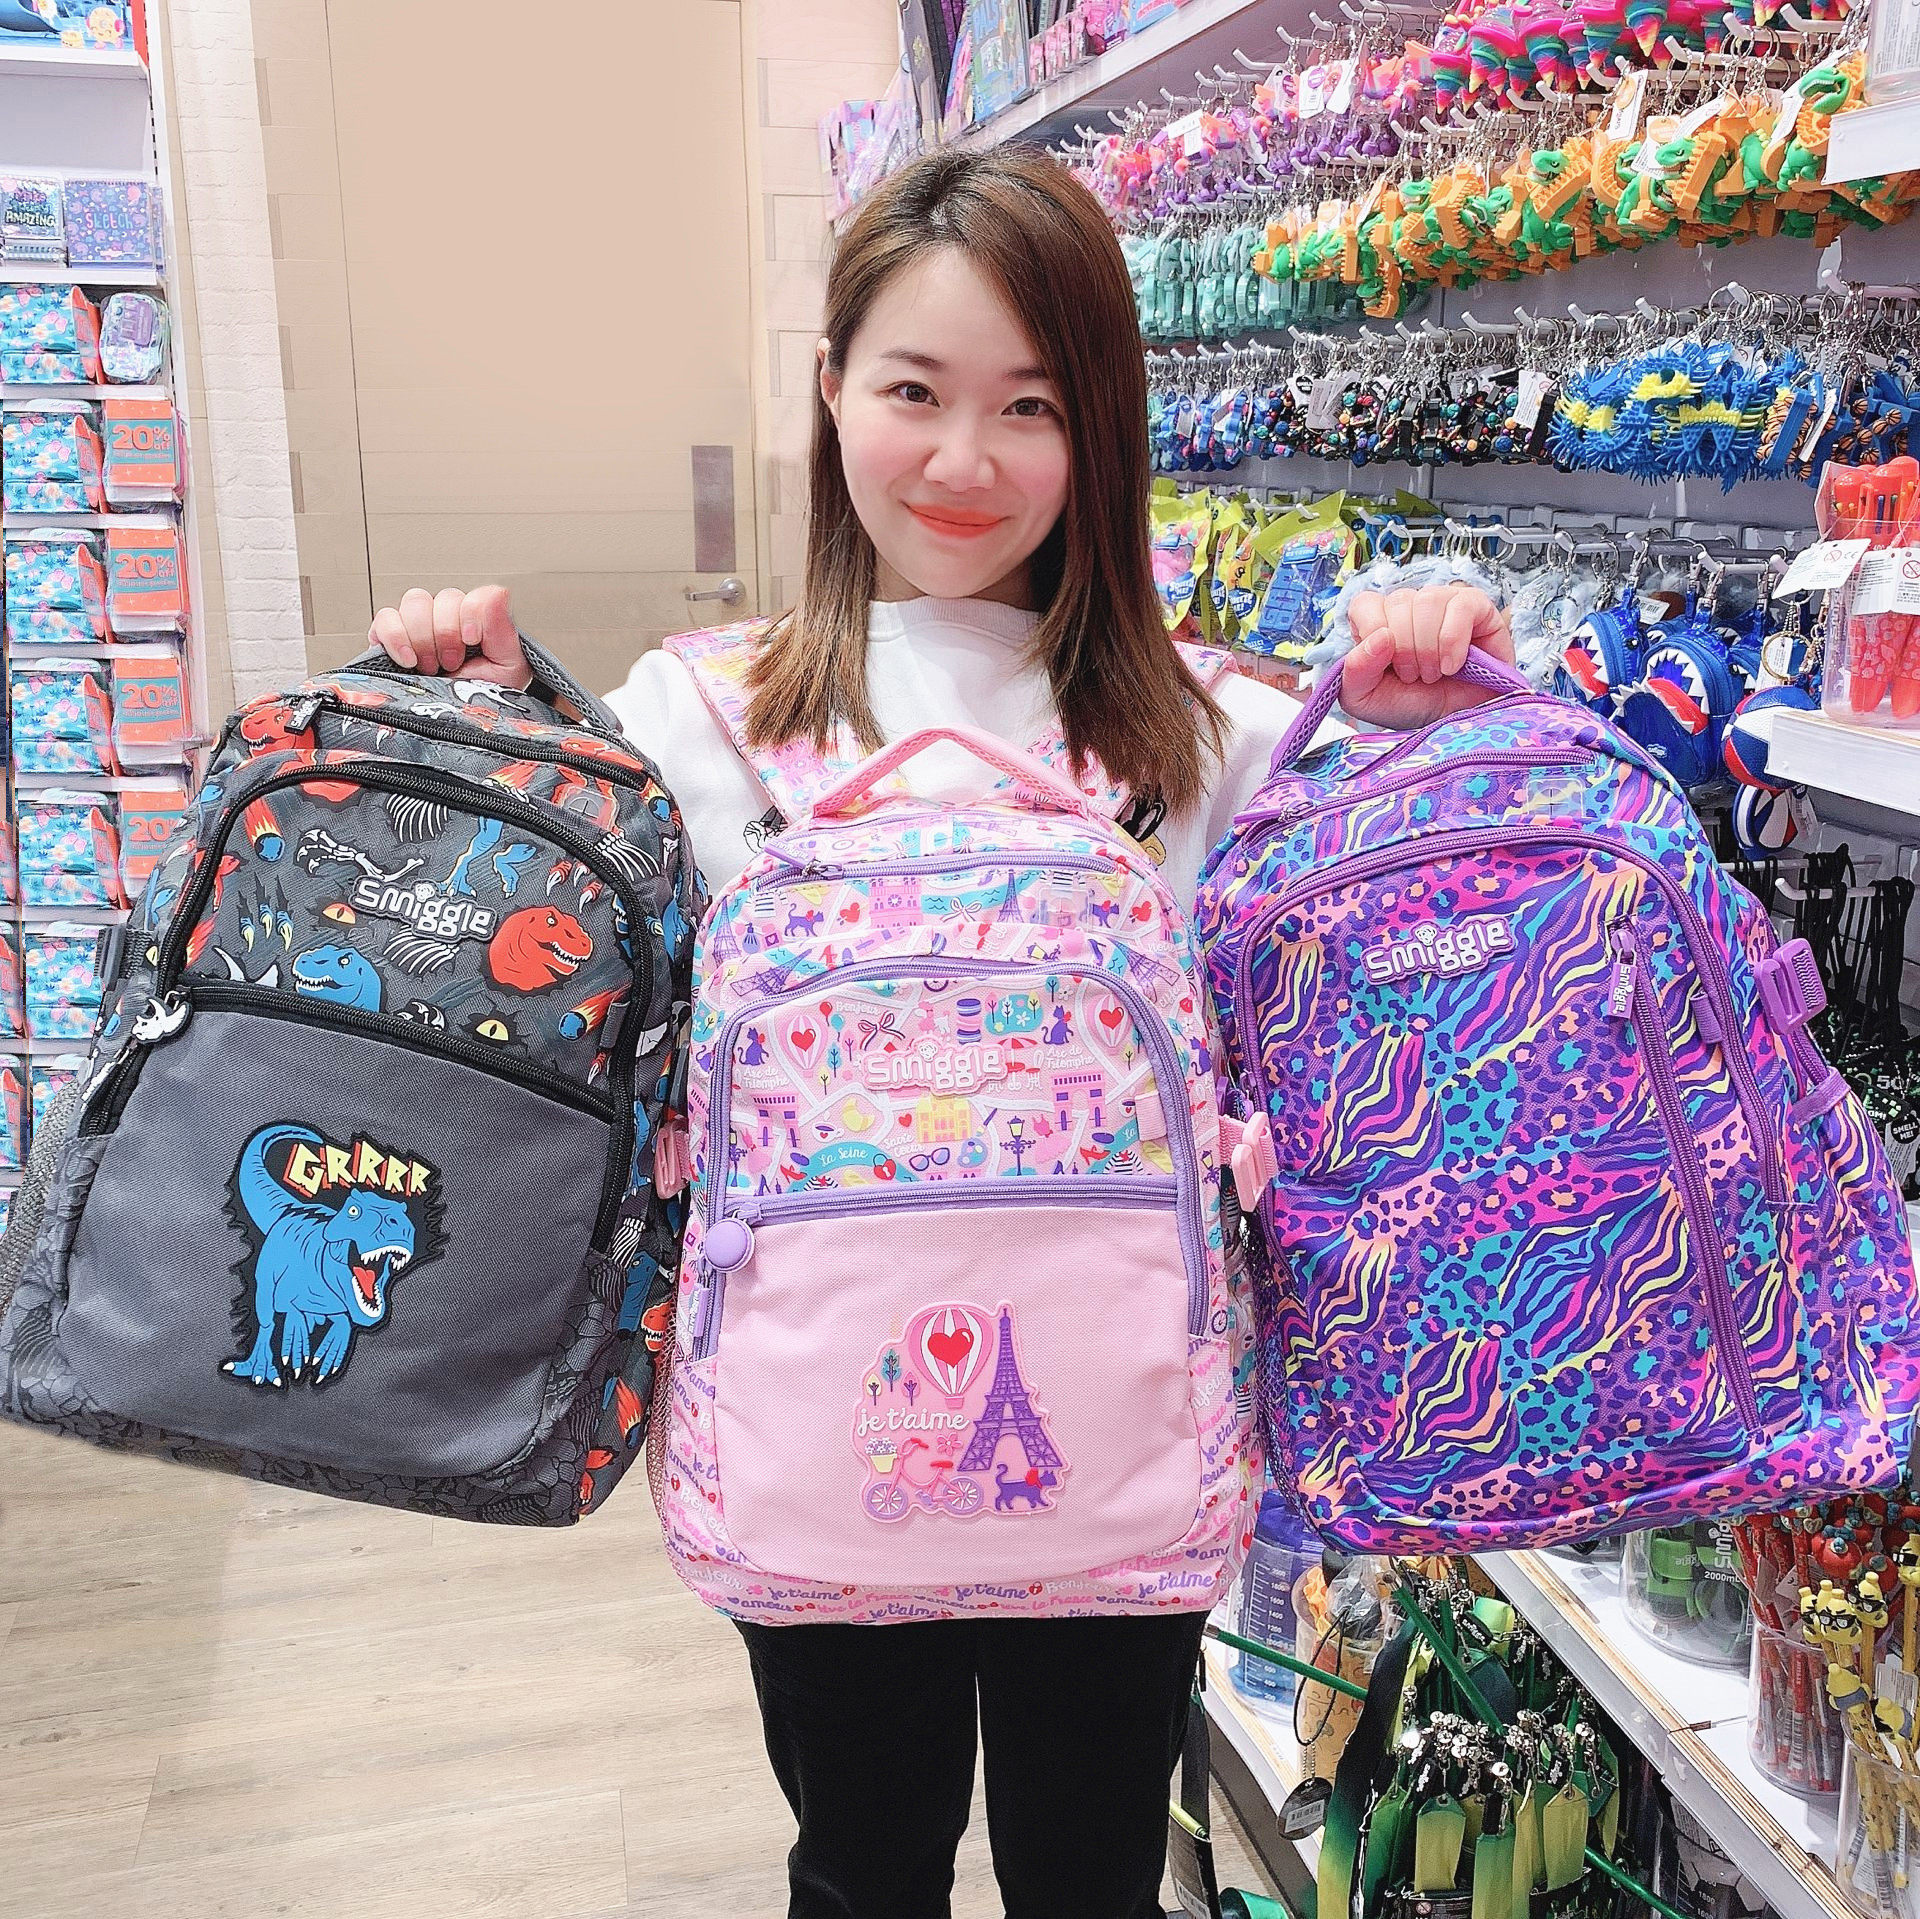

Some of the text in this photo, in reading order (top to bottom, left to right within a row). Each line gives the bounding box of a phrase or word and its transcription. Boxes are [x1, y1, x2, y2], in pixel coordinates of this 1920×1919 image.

[5, 210, 55, 227] AMAZING
[355, 880, 491, 937] smiggle
[1366, 919, 1509, 979] smiggle
[868, 1045, 1001, 1088] smiggle
[1893, 1122, 1918, 1135] SMELL
[1900, 1130, 1914, 1140] ME!
[838, 1147, 868, 1160] Seine
[283, 1140, 431, 1198] GRRRR
[857, 1407, 970, 1437] je t'aime
[955, 1583, 1029, 1601] je t'aime
[1138, 1571, 1214, 1598] je t'aime
[768, 1587, 843, 1601] je t'aime
[741, 1600, 795, 1612] amour
